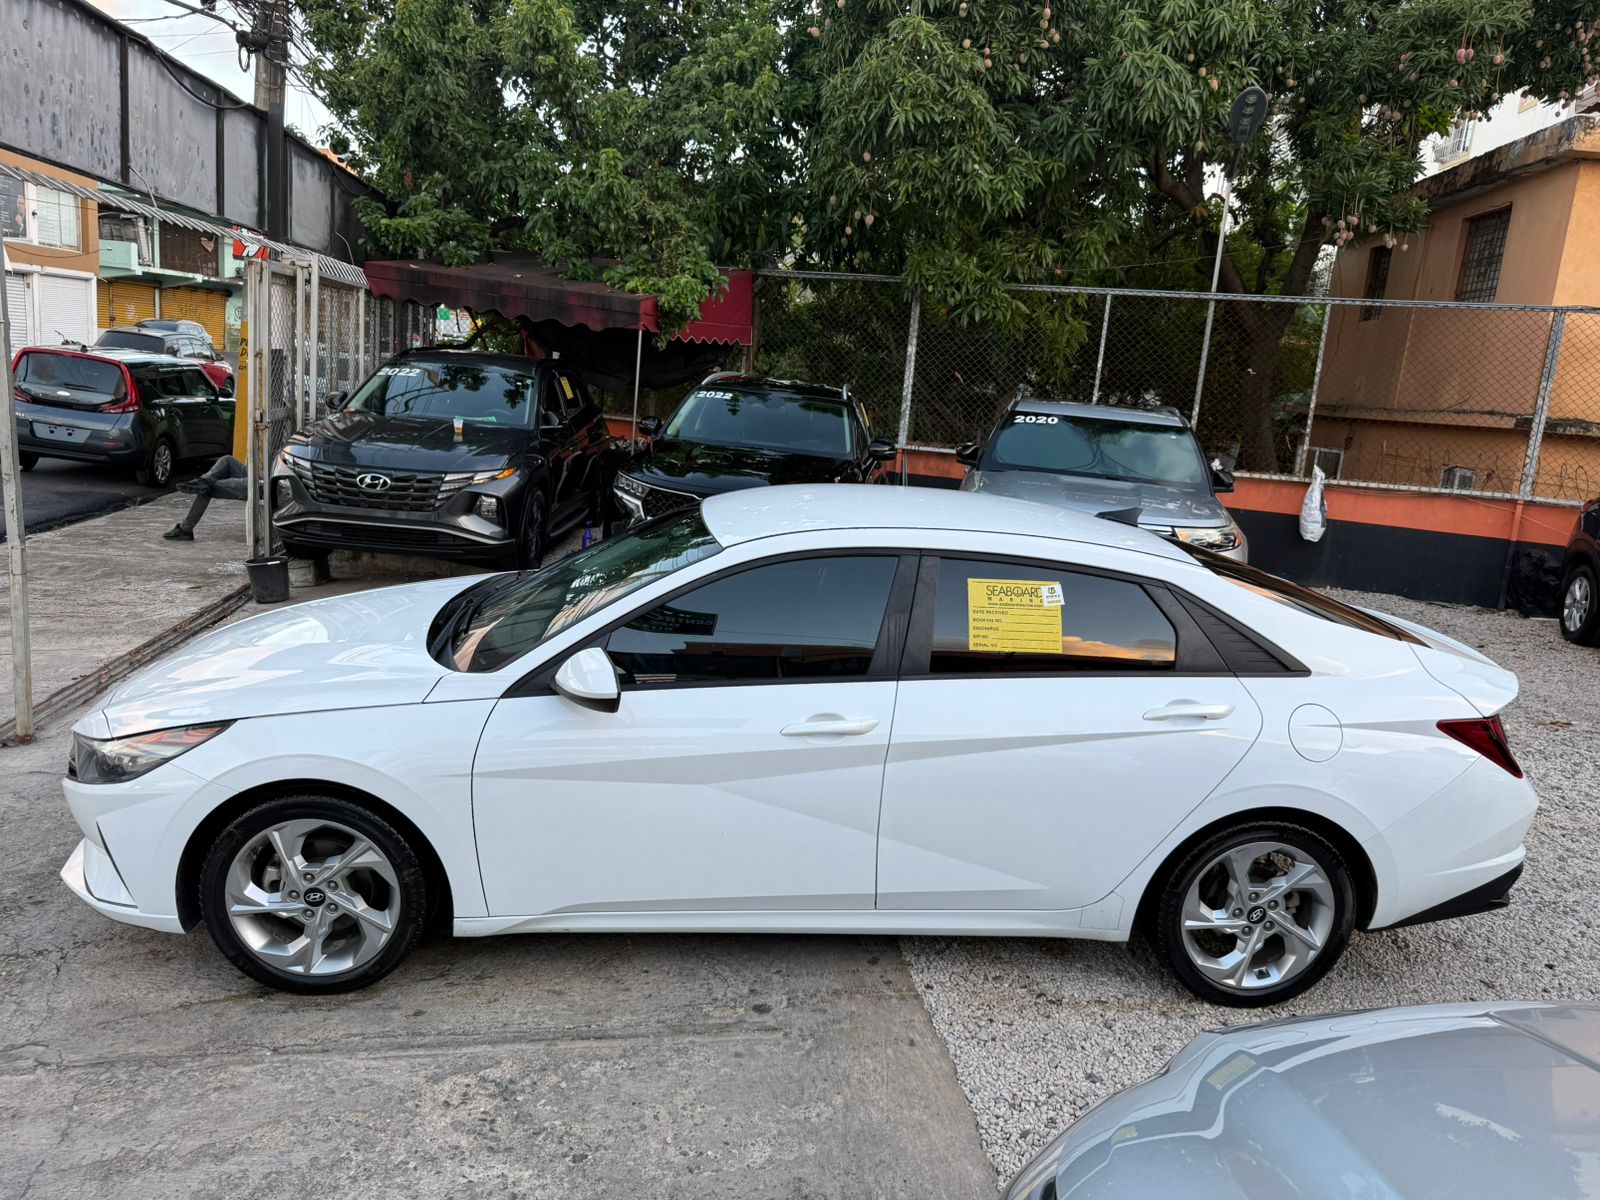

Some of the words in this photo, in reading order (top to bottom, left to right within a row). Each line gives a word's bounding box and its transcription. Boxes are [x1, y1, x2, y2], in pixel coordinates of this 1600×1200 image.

[376, 366, 420, 376] 2022
[696, 390, 733, 399] 2022
[1013, 415, 1059, 424] 2020
